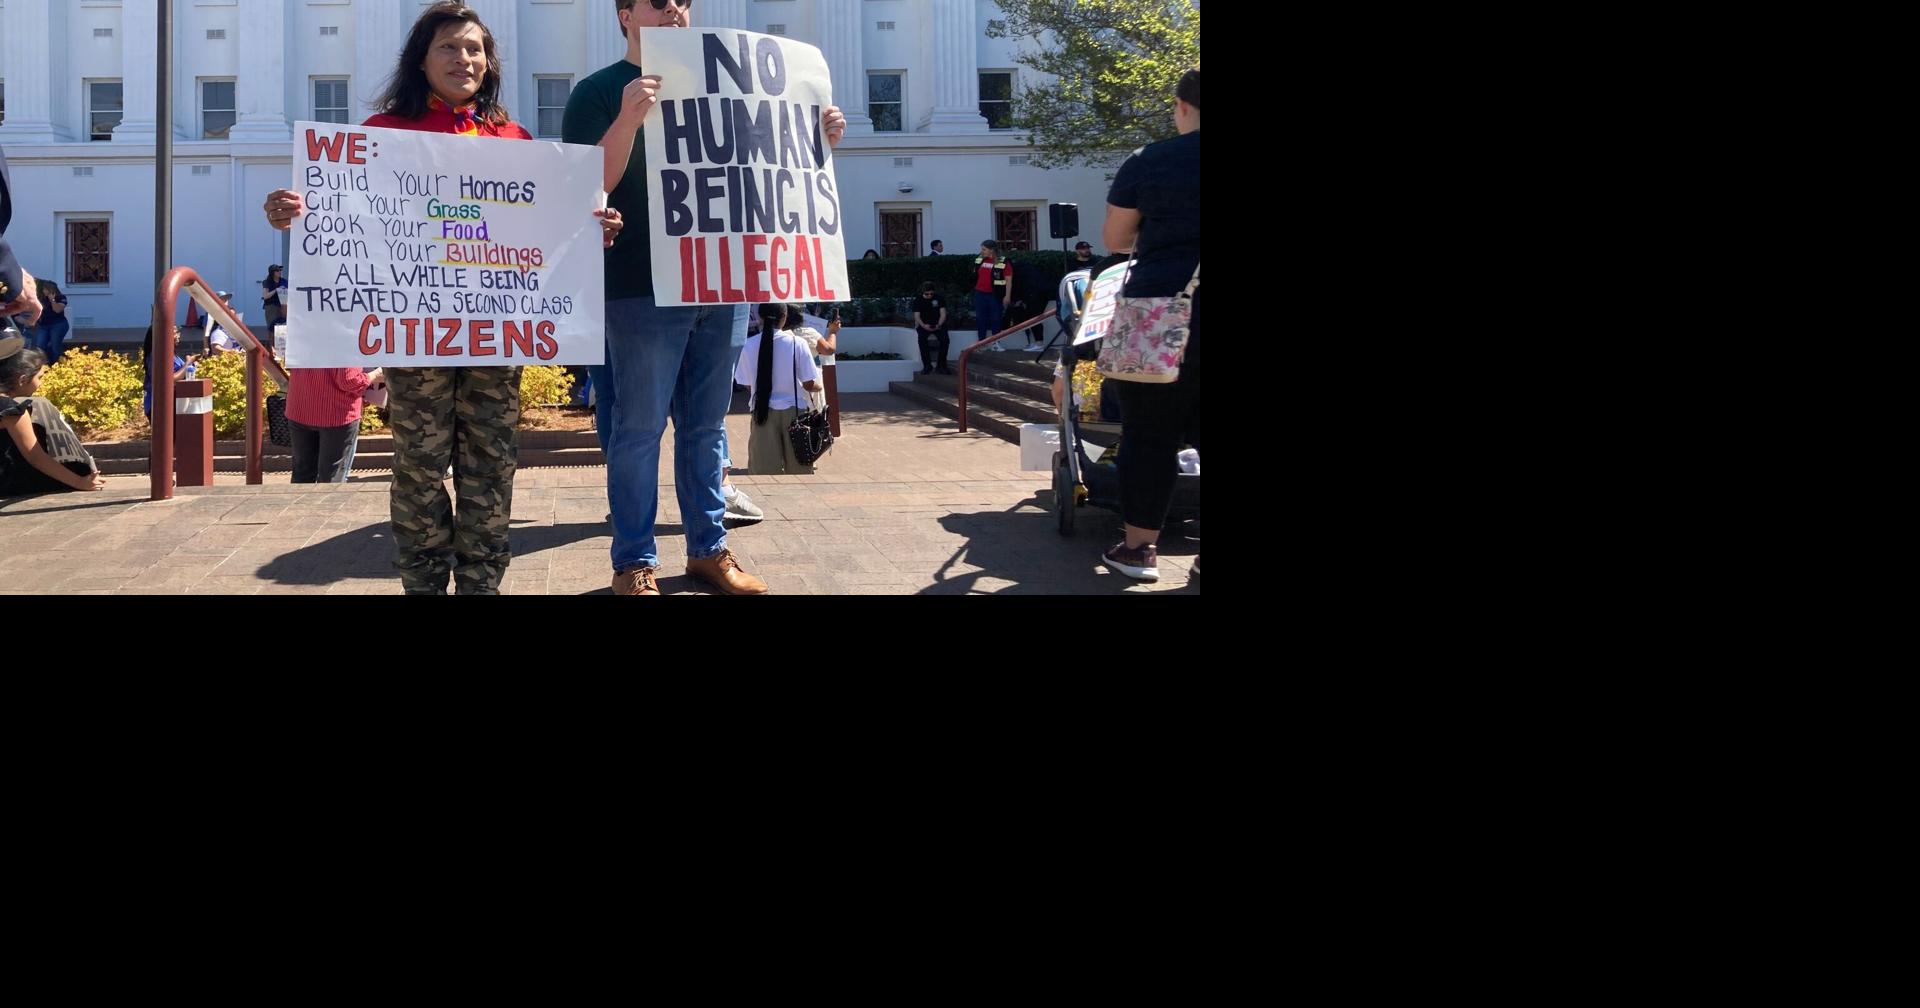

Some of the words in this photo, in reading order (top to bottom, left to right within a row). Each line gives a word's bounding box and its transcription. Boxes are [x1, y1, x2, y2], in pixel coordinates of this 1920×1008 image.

[702, 33, 786, 97] NO
[305, 128, 379, 165] WE:
[661, 96, 825, 170] HUMAN
[305, 165, 369, 192] Build
[393, 170, 448, 197] Your
[304, 190, 348, 213] Cut
[366, 194, 410, 216] Your
[661, 165, 800, 236] BEING
[805, 169, 839, 236] IS
[380, 218, 428, 238] Your
[303, 234, 368, 259] Clean
[384, 240, 437, 263] Your
[335, 263, 385, 286] ALL
[391, 264, 468, 288] WHILE
[480, 269, 539, 292] BEING
[679, 234, 836, 303] ILLEGAL
[296, 286, 408, 313] TREATED
[417, 291, 441, 313] AS
[453, 292, 516, 315] SECOND
[521, 295, 573, 315] CLASS
[358, 314, 559, 360] CITIZENS
